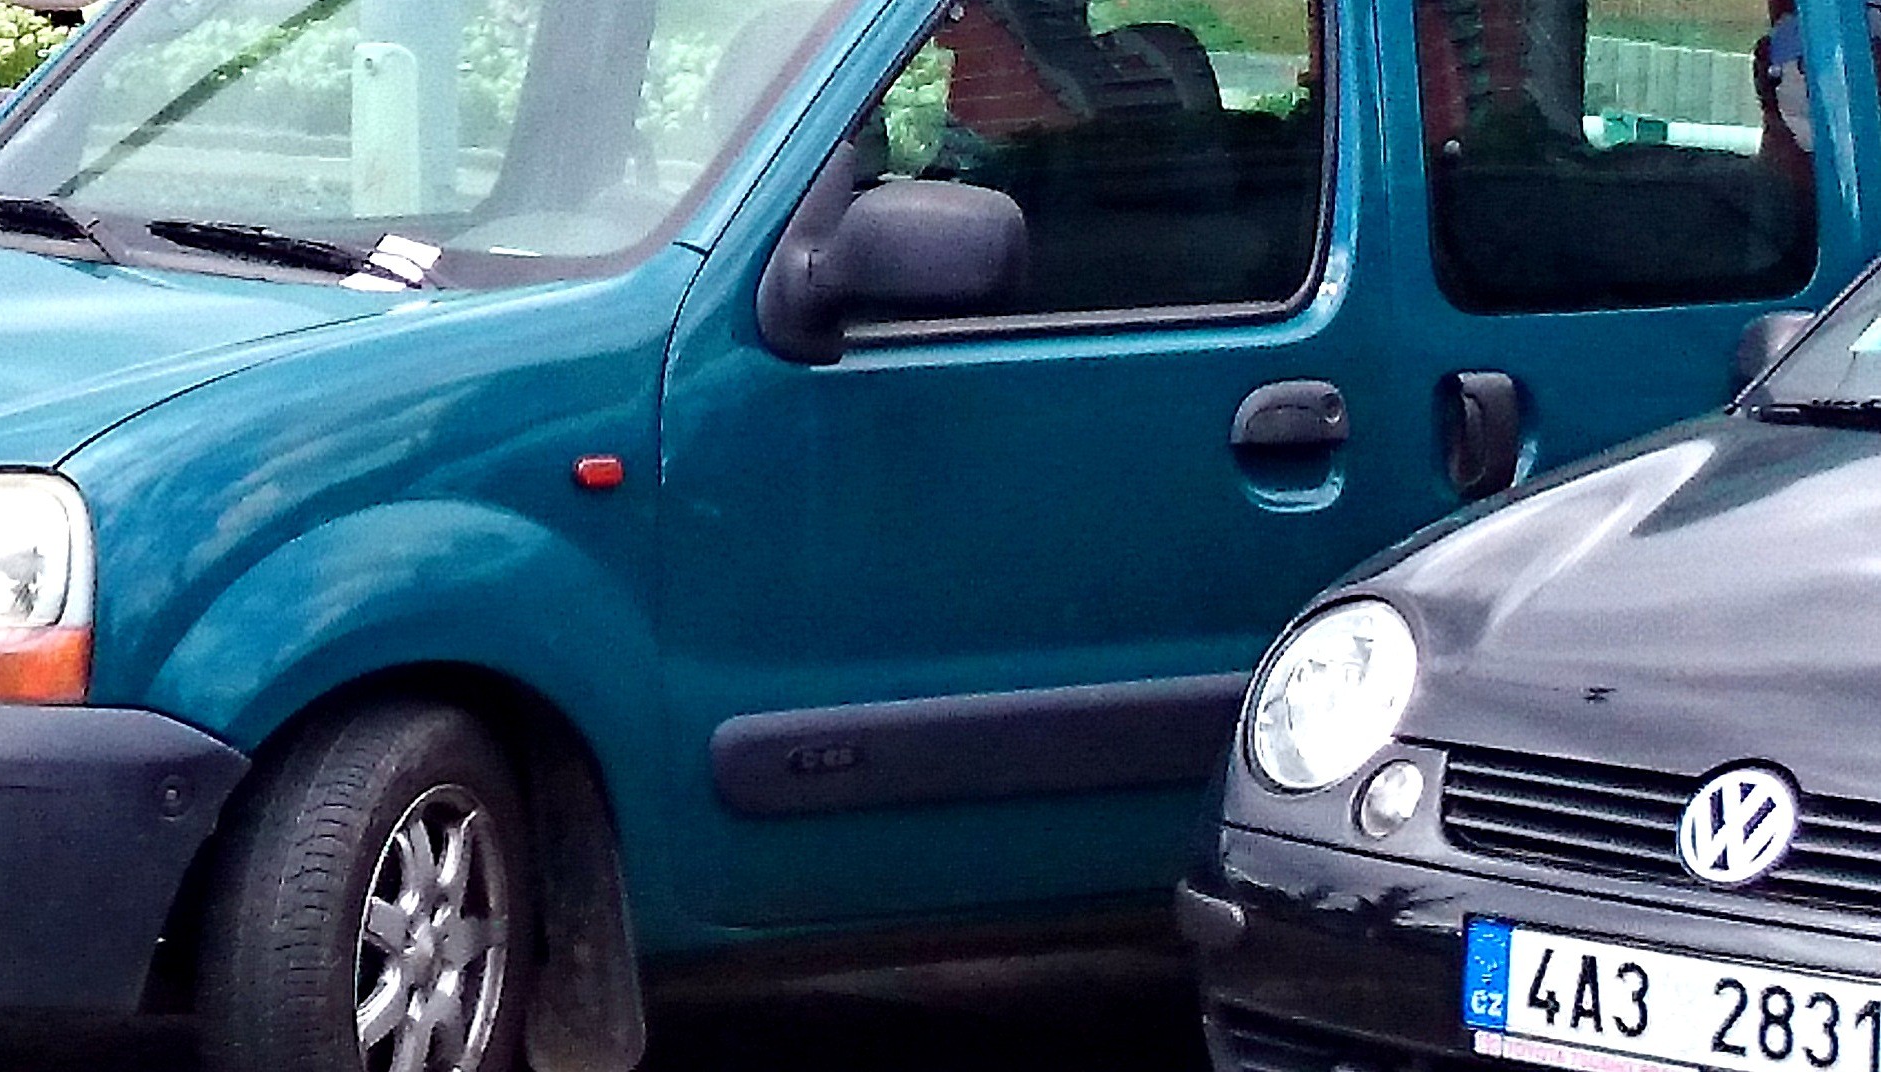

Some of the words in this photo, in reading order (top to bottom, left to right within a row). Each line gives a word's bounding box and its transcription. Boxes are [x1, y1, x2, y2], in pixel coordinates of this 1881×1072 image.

[1470, 988, 1504, 1018] CZ
[1526, 948, 1650, 1038] 4A3
[1710, 976, 1881, 1072] 2831
